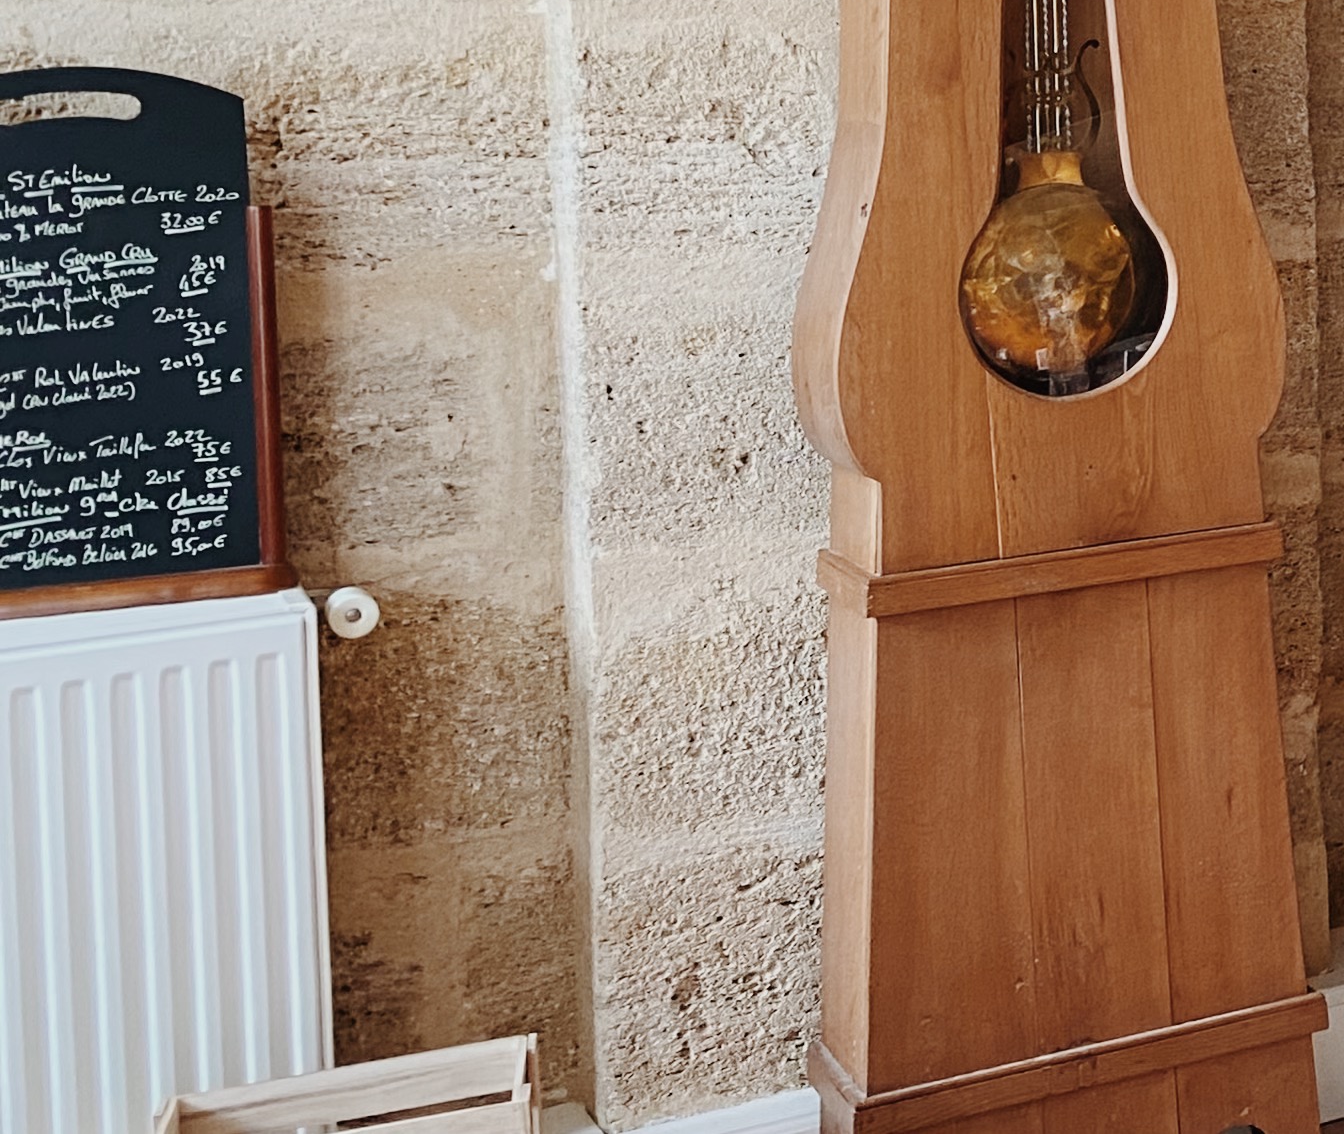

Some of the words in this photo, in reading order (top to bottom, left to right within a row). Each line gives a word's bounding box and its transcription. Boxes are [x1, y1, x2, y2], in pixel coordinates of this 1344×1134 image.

[195, 185, 240, 202] 2020
[189, 255, 225, 272] 2019
[152, 307, 201, 324] 2022
[160, 352, 204, 371] 2019
[198, 368, 221, 388] 55
[164, 430, 211, 447] 2022
[145, 469, 185, 485] 2015
[100, 523, 133, 539] 2019
